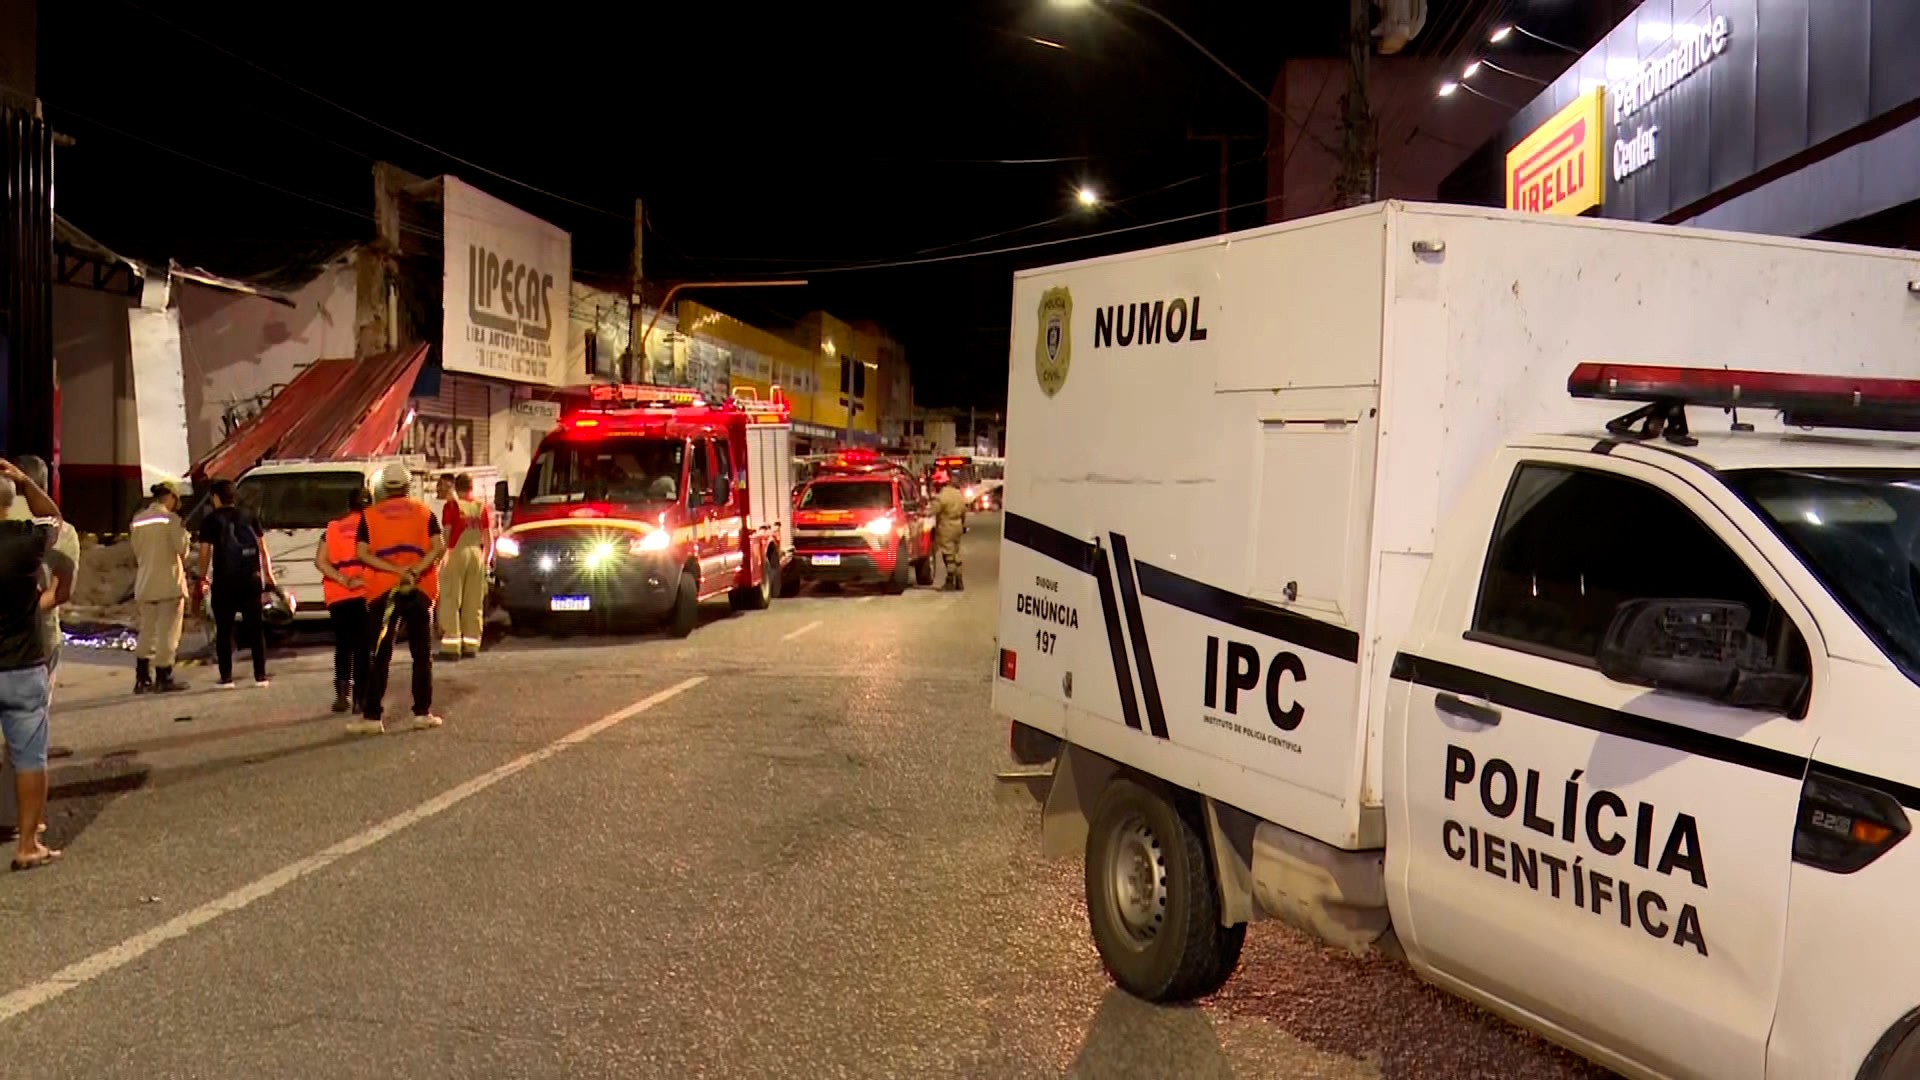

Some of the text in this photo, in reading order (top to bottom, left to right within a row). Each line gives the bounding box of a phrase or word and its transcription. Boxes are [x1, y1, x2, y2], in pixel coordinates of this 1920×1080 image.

[1613, 15, 1728, 125] Performance
[1613, 126, 1658, 182] Center
[1094, 296, 1207, 348] NUMOL
[1016, 593, 1079, 630] DENÚNCIA
[1035, 629, 1057, 656] 197
[1204, 635, 1307, 731] IPC
[1203, 715, 1233, 731] INSTITUTO
[1233, 723, 1242, 734] DE
[1444, 743, 1709, 889] POLÍCIA
[1442, 819, 1709, 958] CIENTÍFICA
